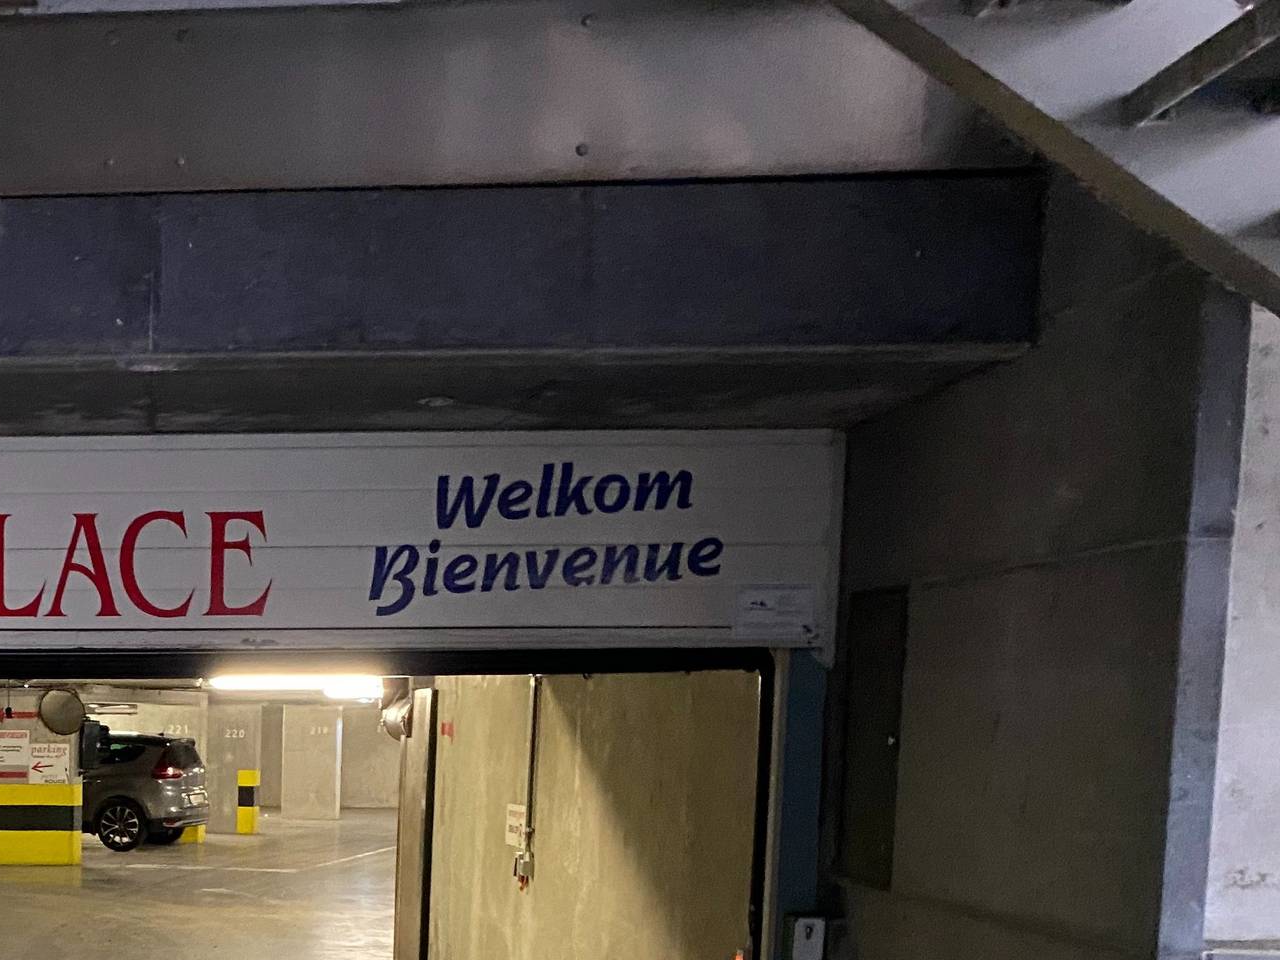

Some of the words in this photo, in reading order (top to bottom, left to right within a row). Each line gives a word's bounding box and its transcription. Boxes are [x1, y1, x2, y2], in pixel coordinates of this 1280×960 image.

[436, 461, 693, 530] Welkom
[368, 536, 724, 617] Bienvenue
[167, 724, 189, 735] 221
[224, 729, 245, 738] 220
